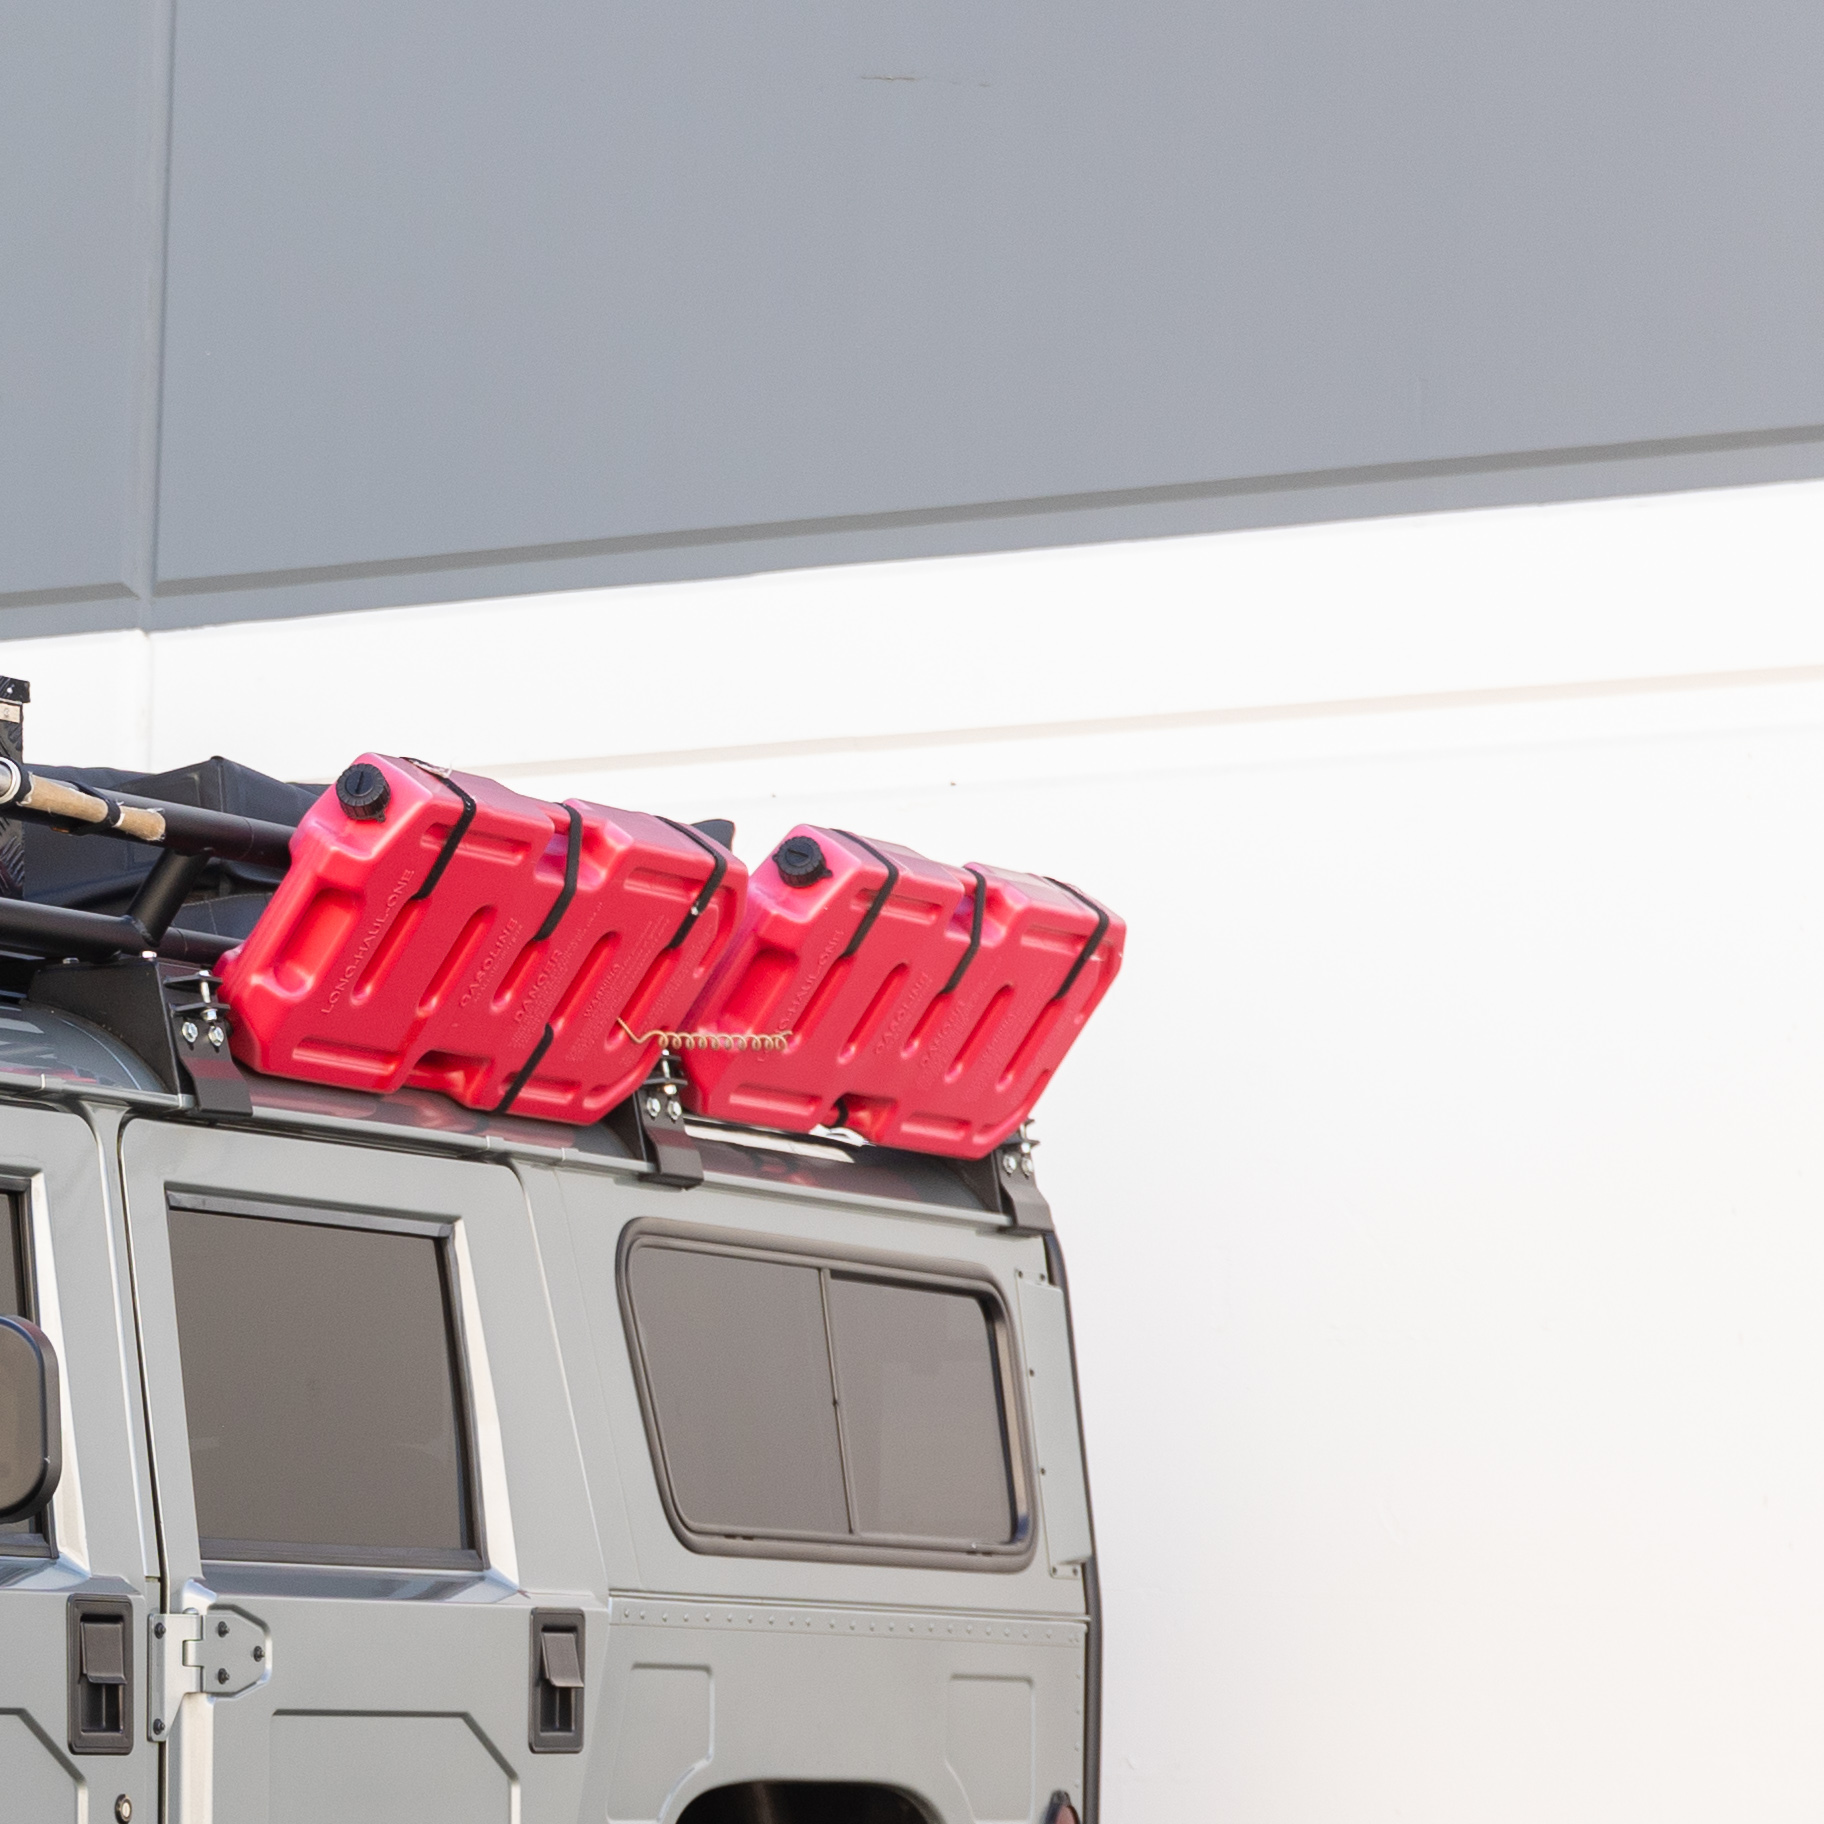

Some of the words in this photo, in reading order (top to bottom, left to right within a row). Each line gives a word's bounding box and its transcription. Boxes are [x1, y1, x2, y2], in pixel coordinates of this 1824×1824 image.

[318, 866, 419, 1016] LONG-HAUL-ONE
[456, 915, 521, 1008] GASOLINE
[511, 946, 565, 1024] DANGER
